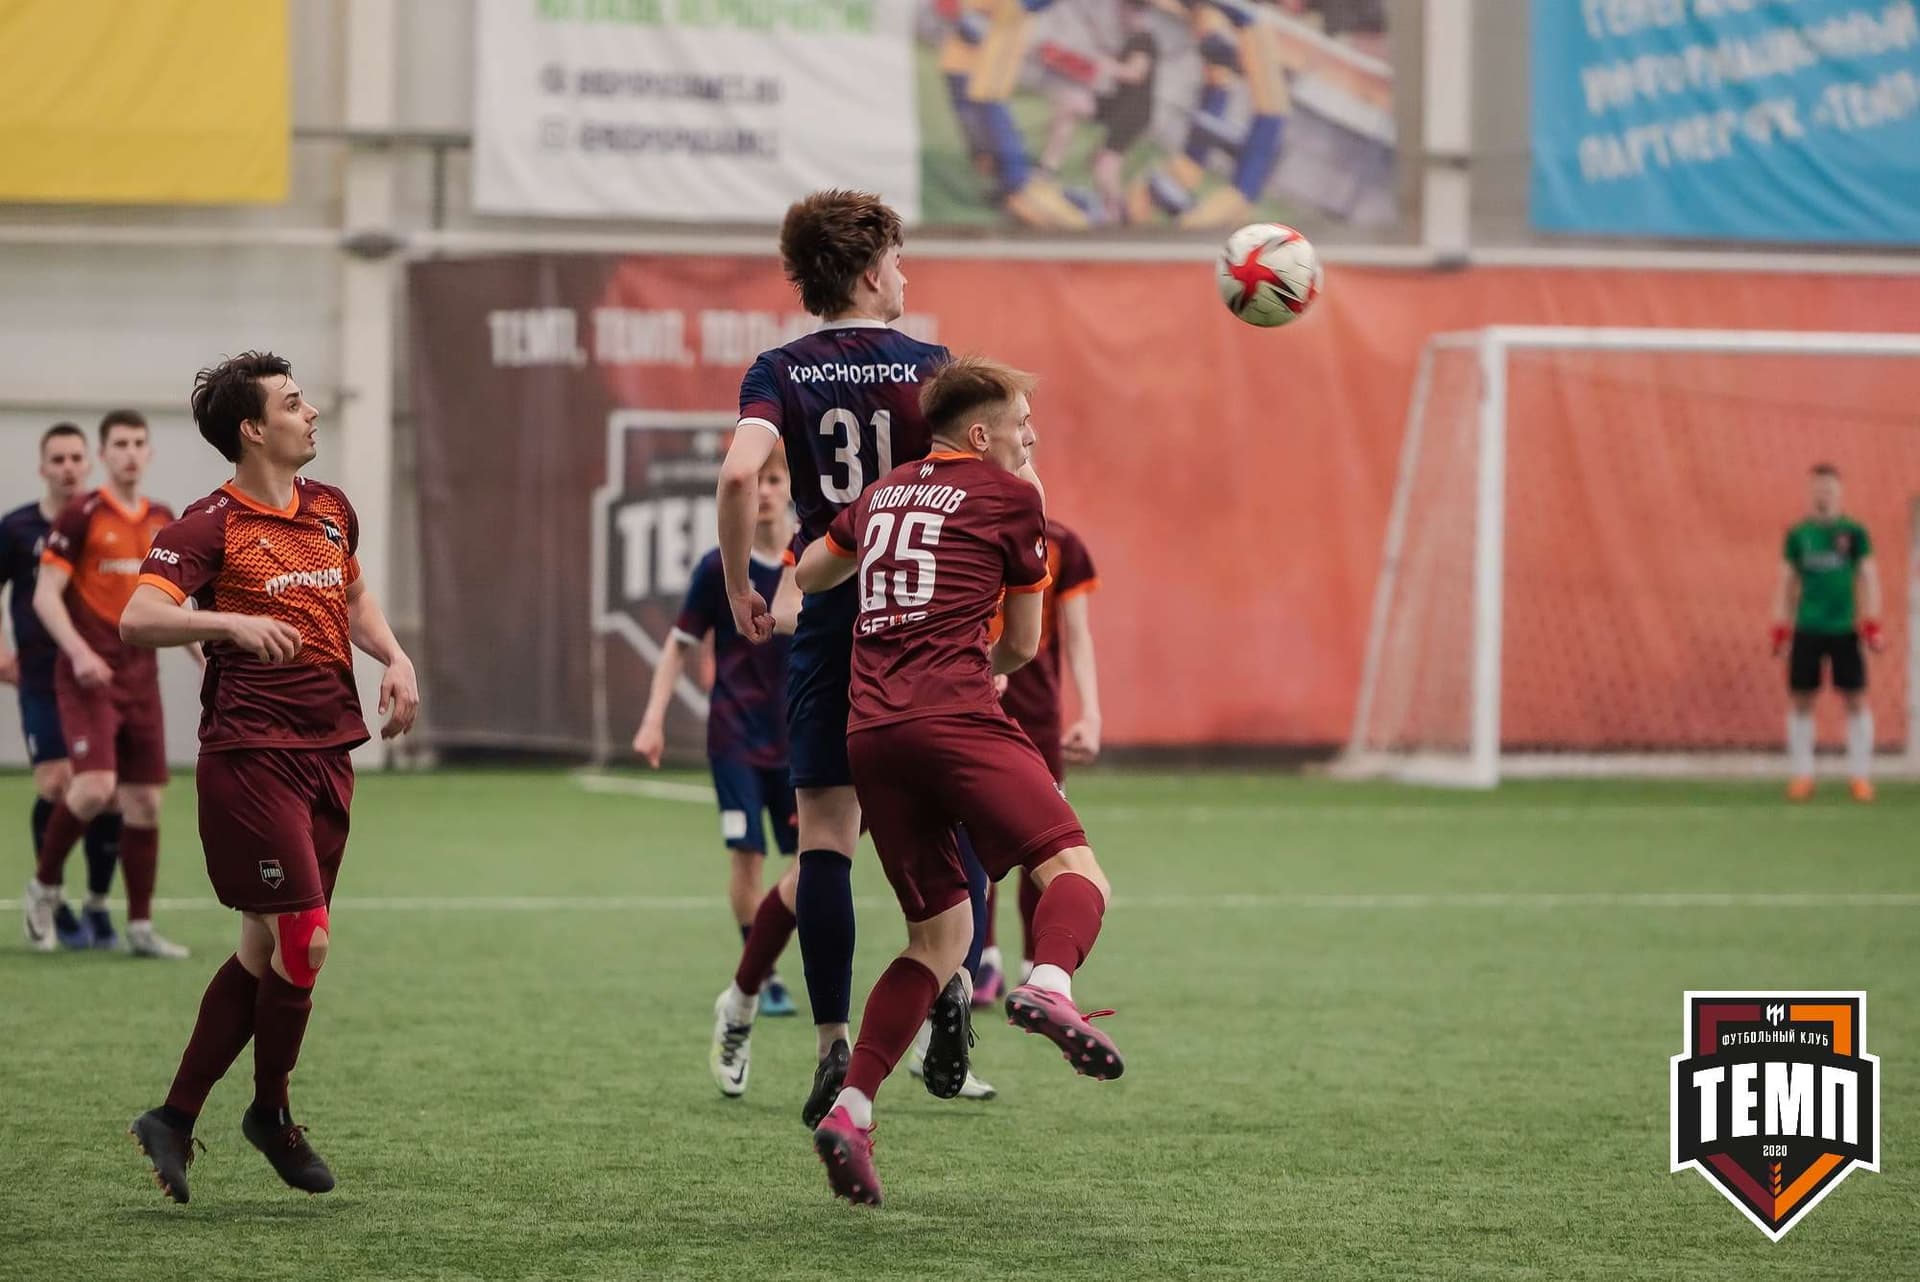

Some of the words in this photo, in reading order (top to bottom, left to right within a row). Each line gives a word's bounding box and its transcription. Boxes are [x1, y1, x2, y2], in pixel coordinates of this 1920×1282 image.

[788, 362, 918, 385] КРАСНОЯРСК
[818, 407, 892, 504] 31
[868, 485, 966, 513] НОВИЧКОВ
[149, 547, 180, 565] ПСБ
[859, 511, 945, 614] 25
